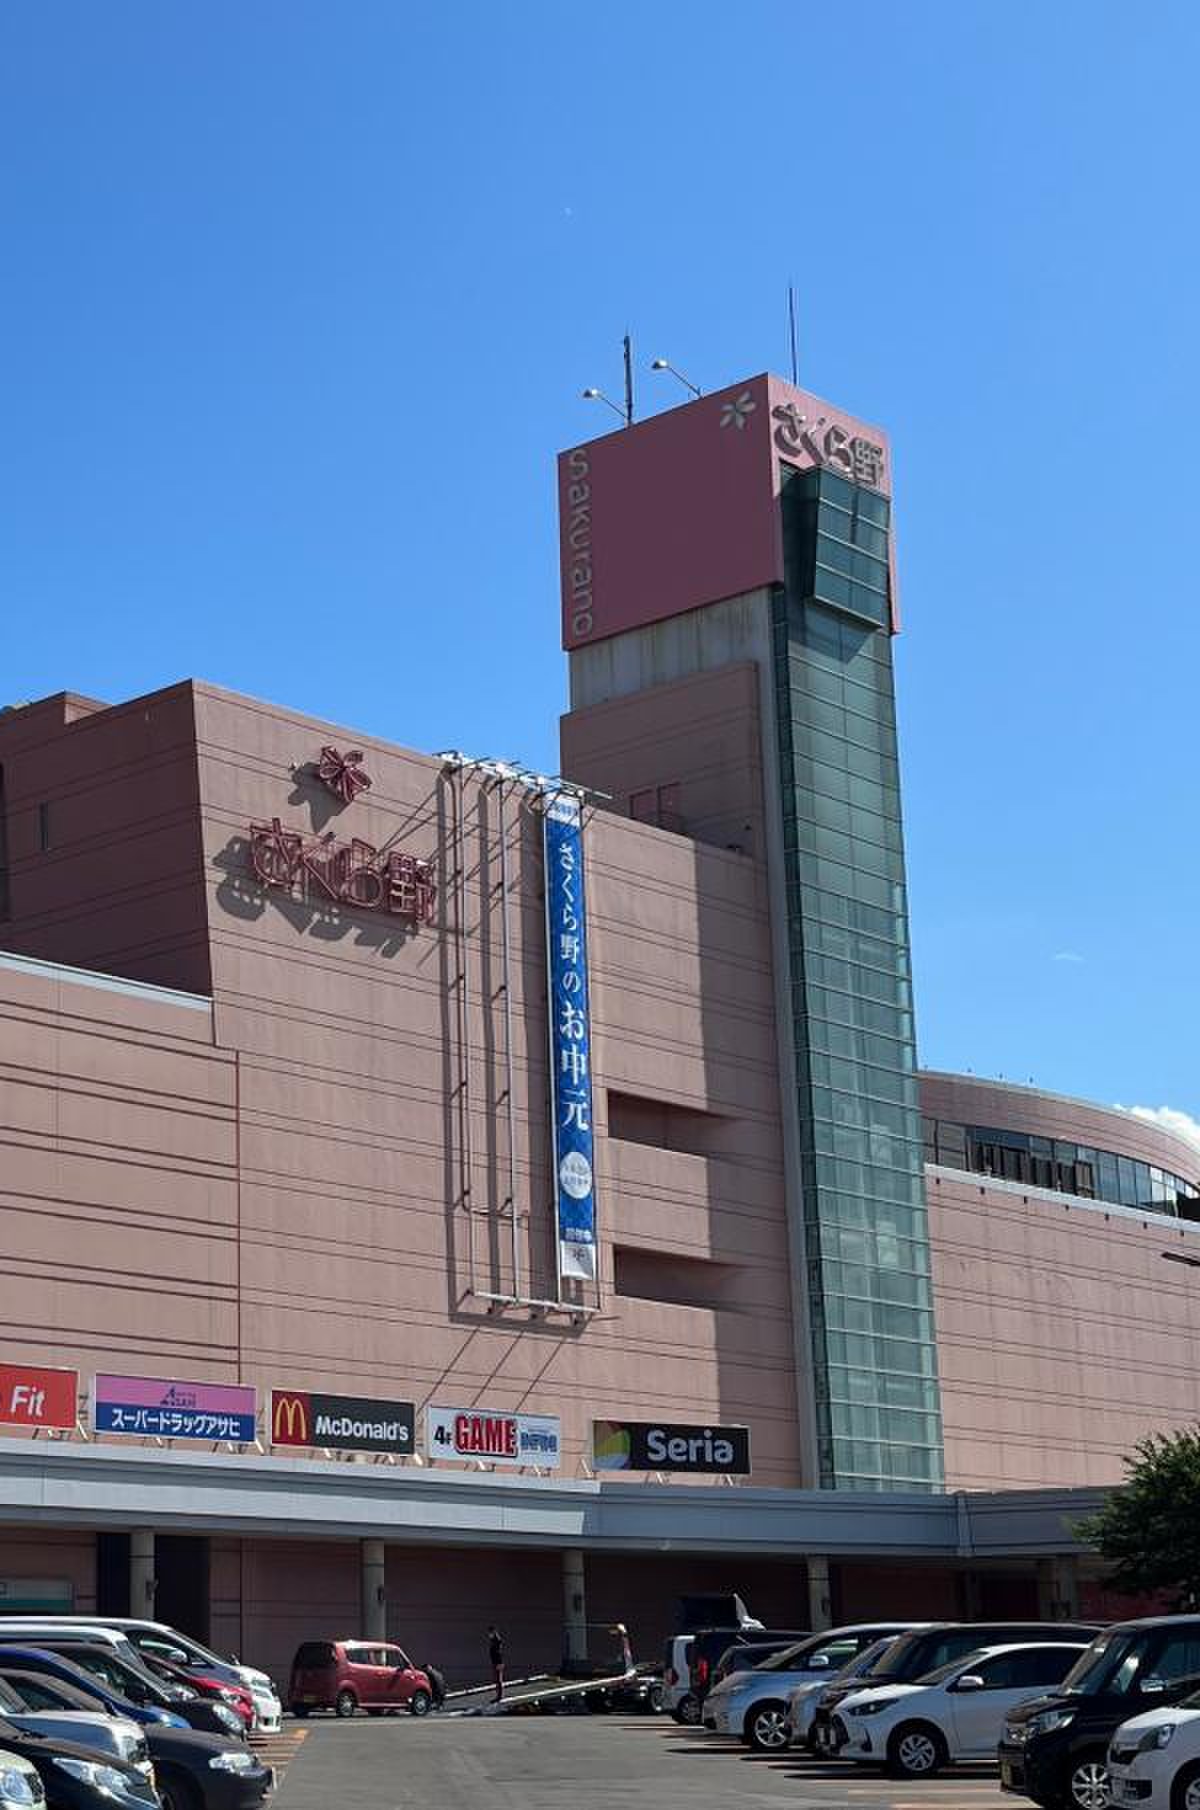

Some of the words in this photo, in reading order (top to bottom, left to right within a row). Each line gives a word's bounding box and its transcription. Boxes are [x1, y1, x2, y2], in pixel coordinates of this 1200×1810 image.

[559, 842, 590, 1131] さくら野のお中元
[10, 1385, 46, 1417] Fit
[111, 1408, 241, 1437] スーパードラッグアサヒ
[315, 1415, 409, 1441] McDonald's
[455, 1414, 518, 1457] GAME
[646, 1428, 734, 1464] Seria
